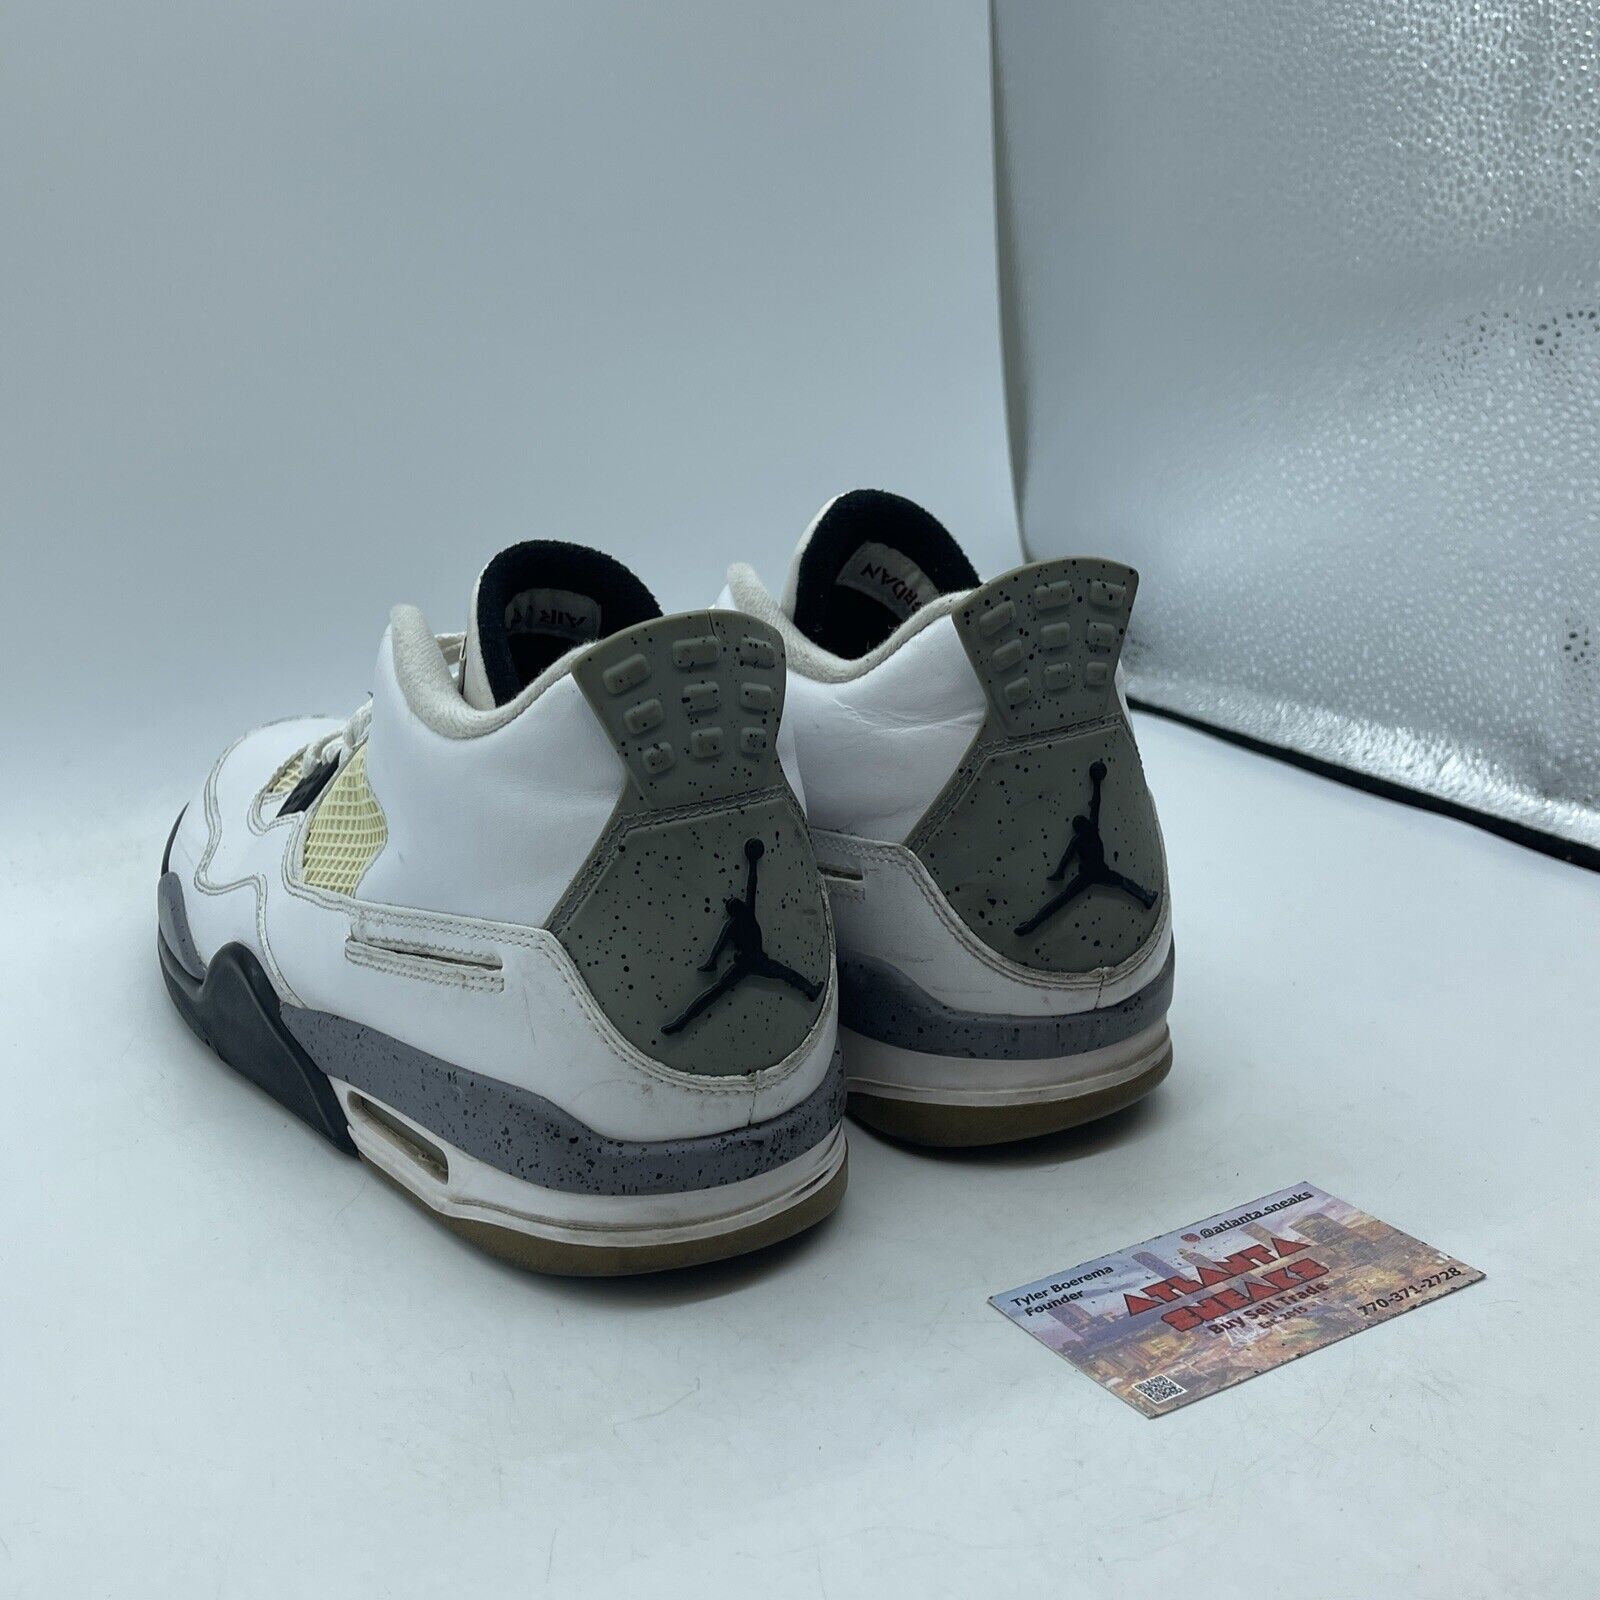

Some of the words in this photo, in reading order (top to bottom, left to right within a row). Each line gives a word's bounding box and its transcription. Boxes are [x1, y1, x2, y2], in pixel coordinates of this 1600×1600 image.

[1199, 1191, 1315, 1239] @atlanta.sneaks
[1010, 1288, 1048, 1307] Tyler
[1050, 1266, 1114, 1293] Boerema
[1123, 1237, 1311, 1317] ATLANTA
[1161, 1257, 1330, 1332] SNEAKS
[1357, 1267, 1462, 1316] 770-371-2728
[1024, 1290, 1084, 1317] Founder
[1208, 1316, 1246, 1335] Buy
[1243, 1301, 1280, 1320] Sell
[1275, 1282, 1329, 1306] Trade
